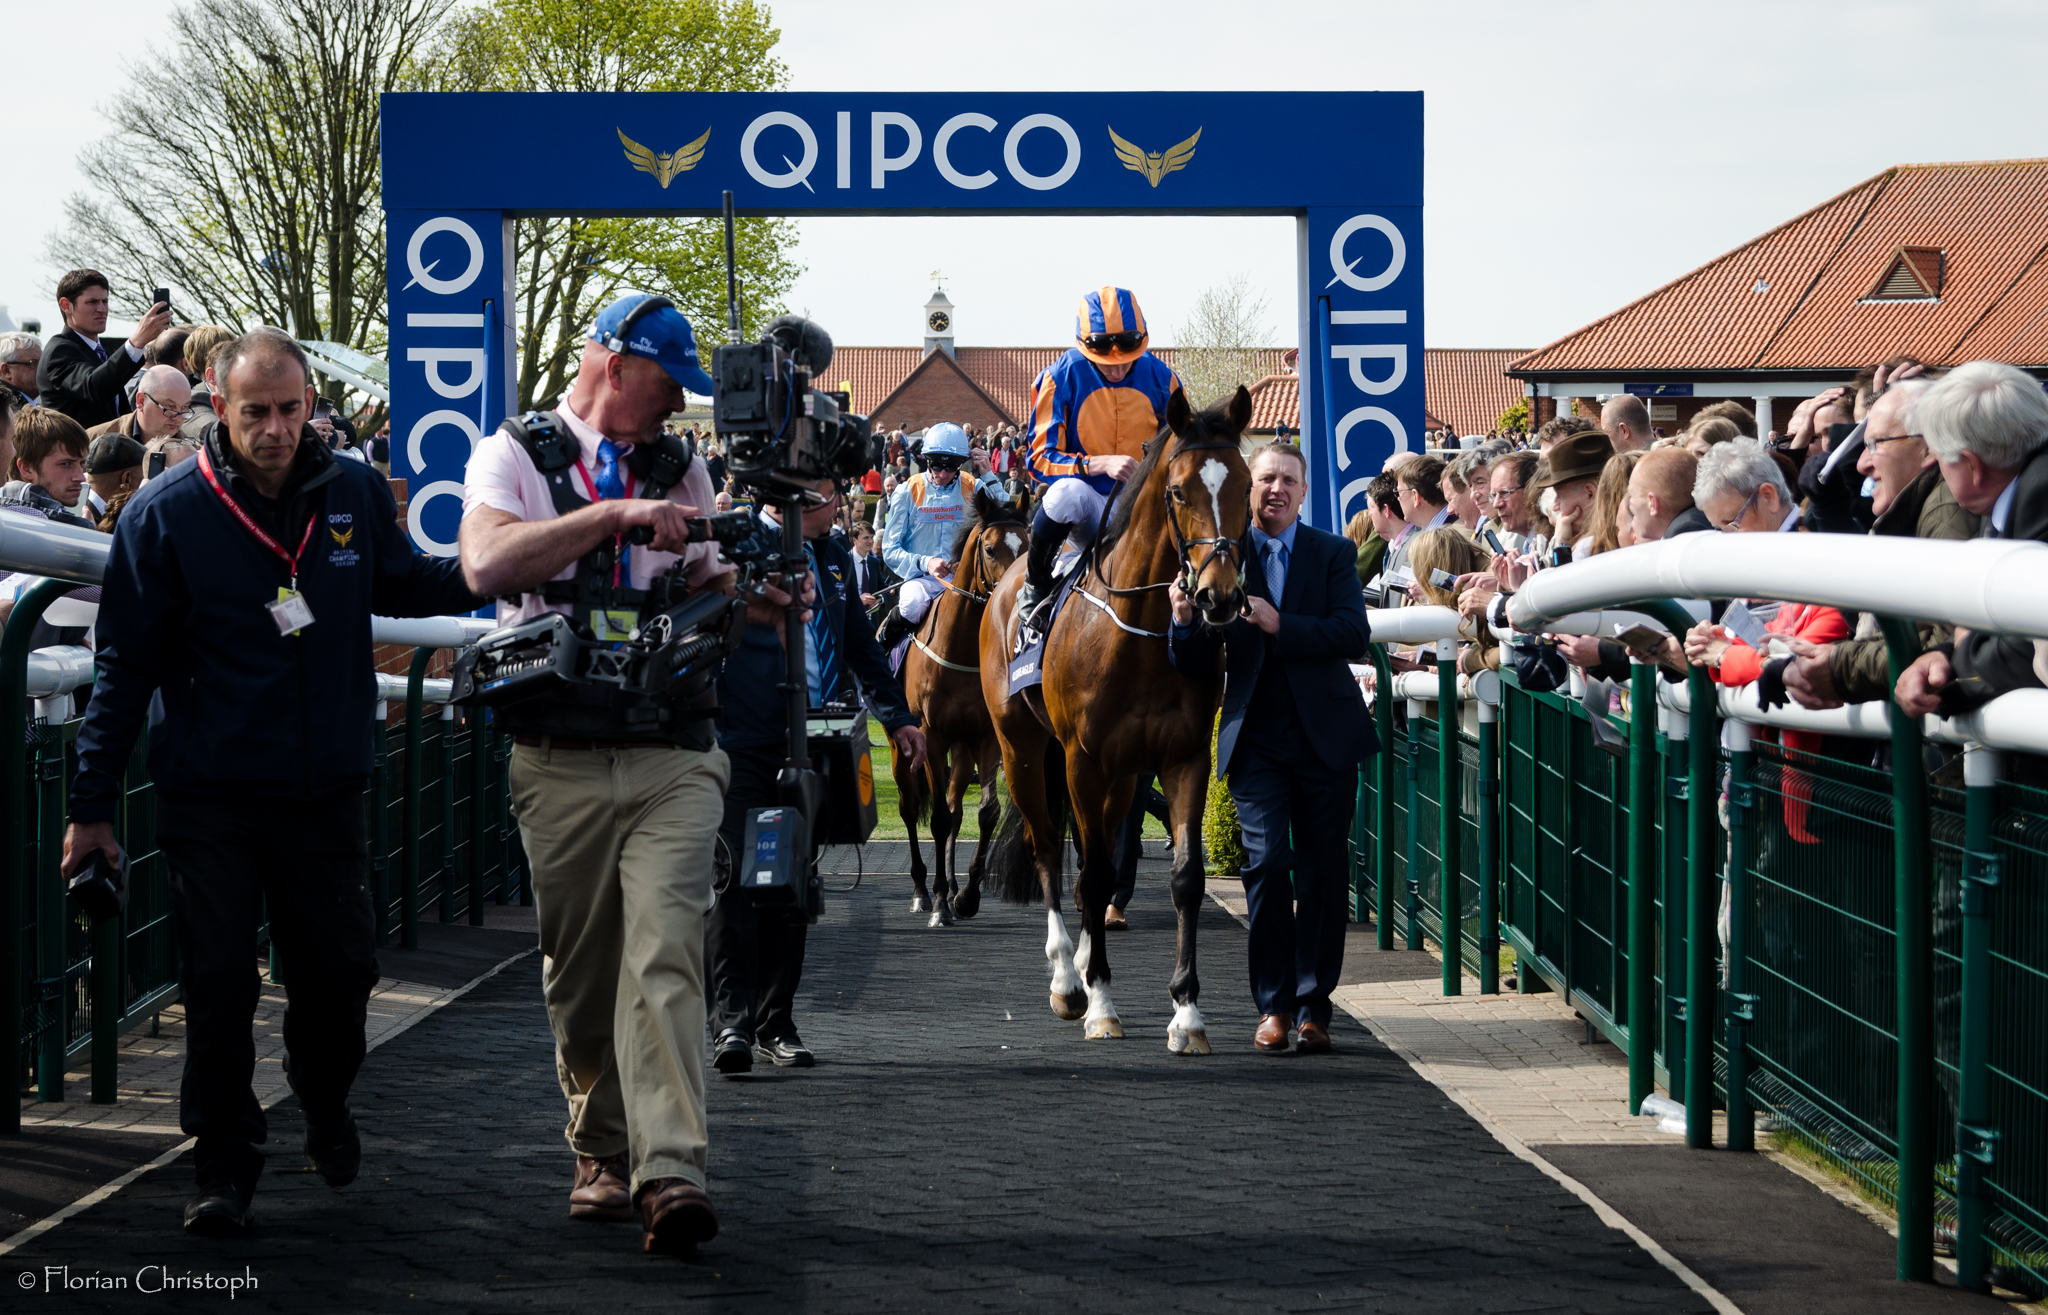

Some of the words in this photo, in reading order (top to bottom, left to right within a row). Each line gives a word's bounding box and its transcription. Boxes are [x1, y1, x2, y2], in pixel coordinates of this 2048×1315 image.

[740, 111, 1081, 195] QIPCO
[629, 341, 659, 355] Emirates
[401, 216, 484, 558] QIPCO
[221, 492, 235, 508] CLUB
[233, 504, 256, 531] FOOTBALL
[920, 506, 954, 514] Middleham
[328, 513, 353, 524] QIPCO
[255, 527, 277, 549] ARSENAL
[329, 554, 360, 562] CHAMPIONS
